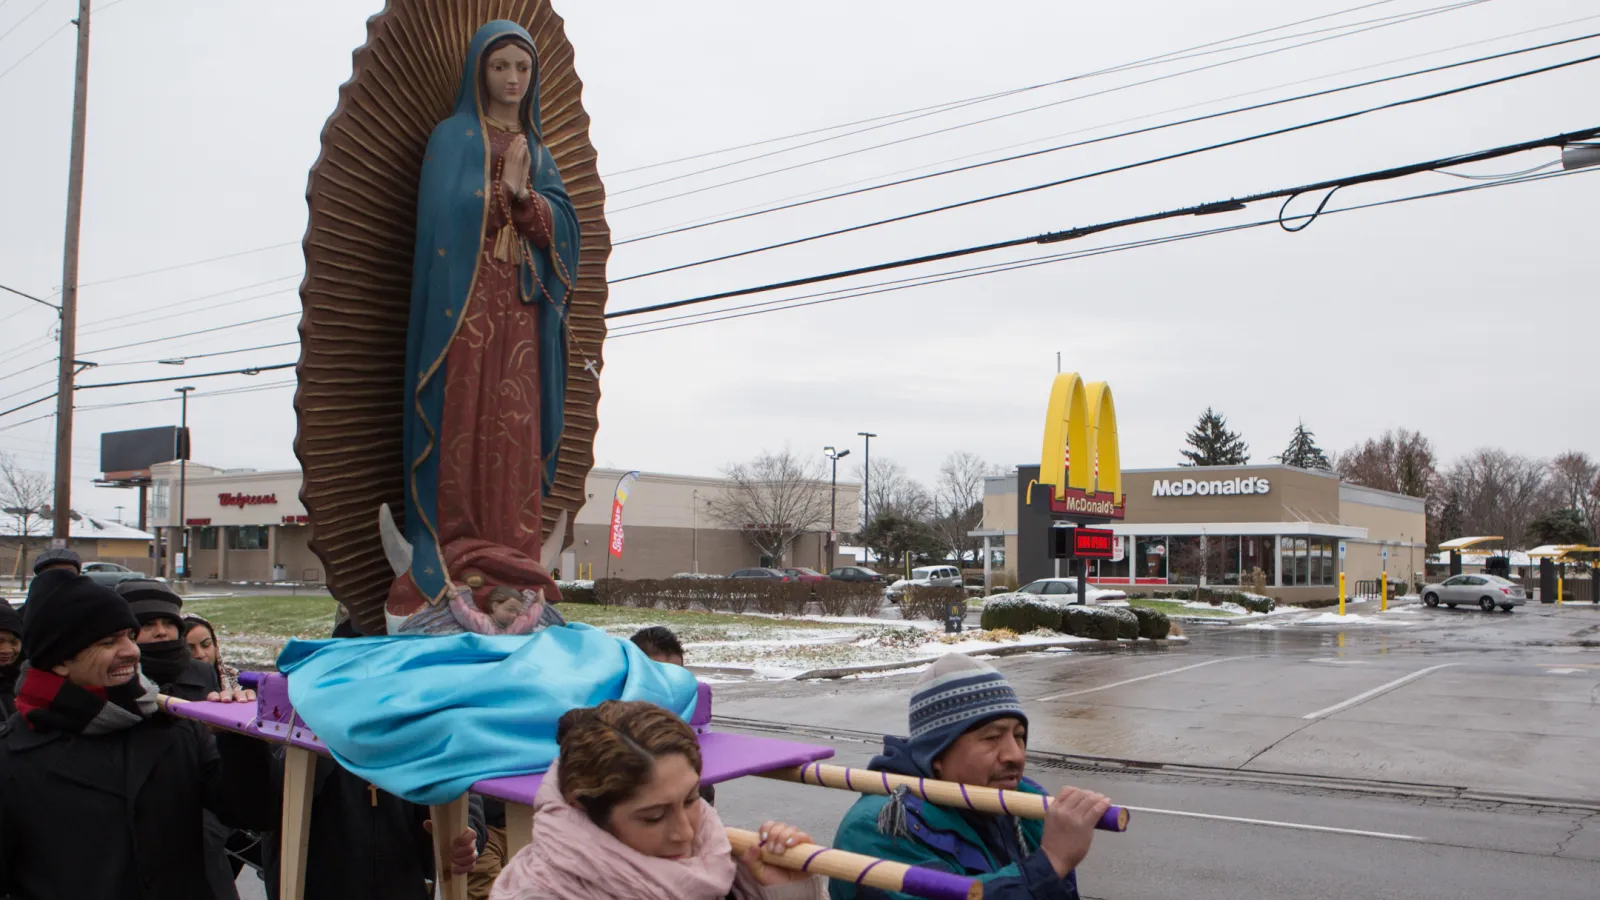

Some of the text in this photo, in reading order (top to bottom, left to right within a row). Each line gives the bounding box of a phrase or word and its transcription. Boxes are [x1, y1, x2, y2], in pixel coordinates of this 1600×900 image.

[1152, 477, 1270, 496] McDonald's
[217, 492, 278, 509] Walgreens
[1066, 496, 1115, 514] McDonald's
